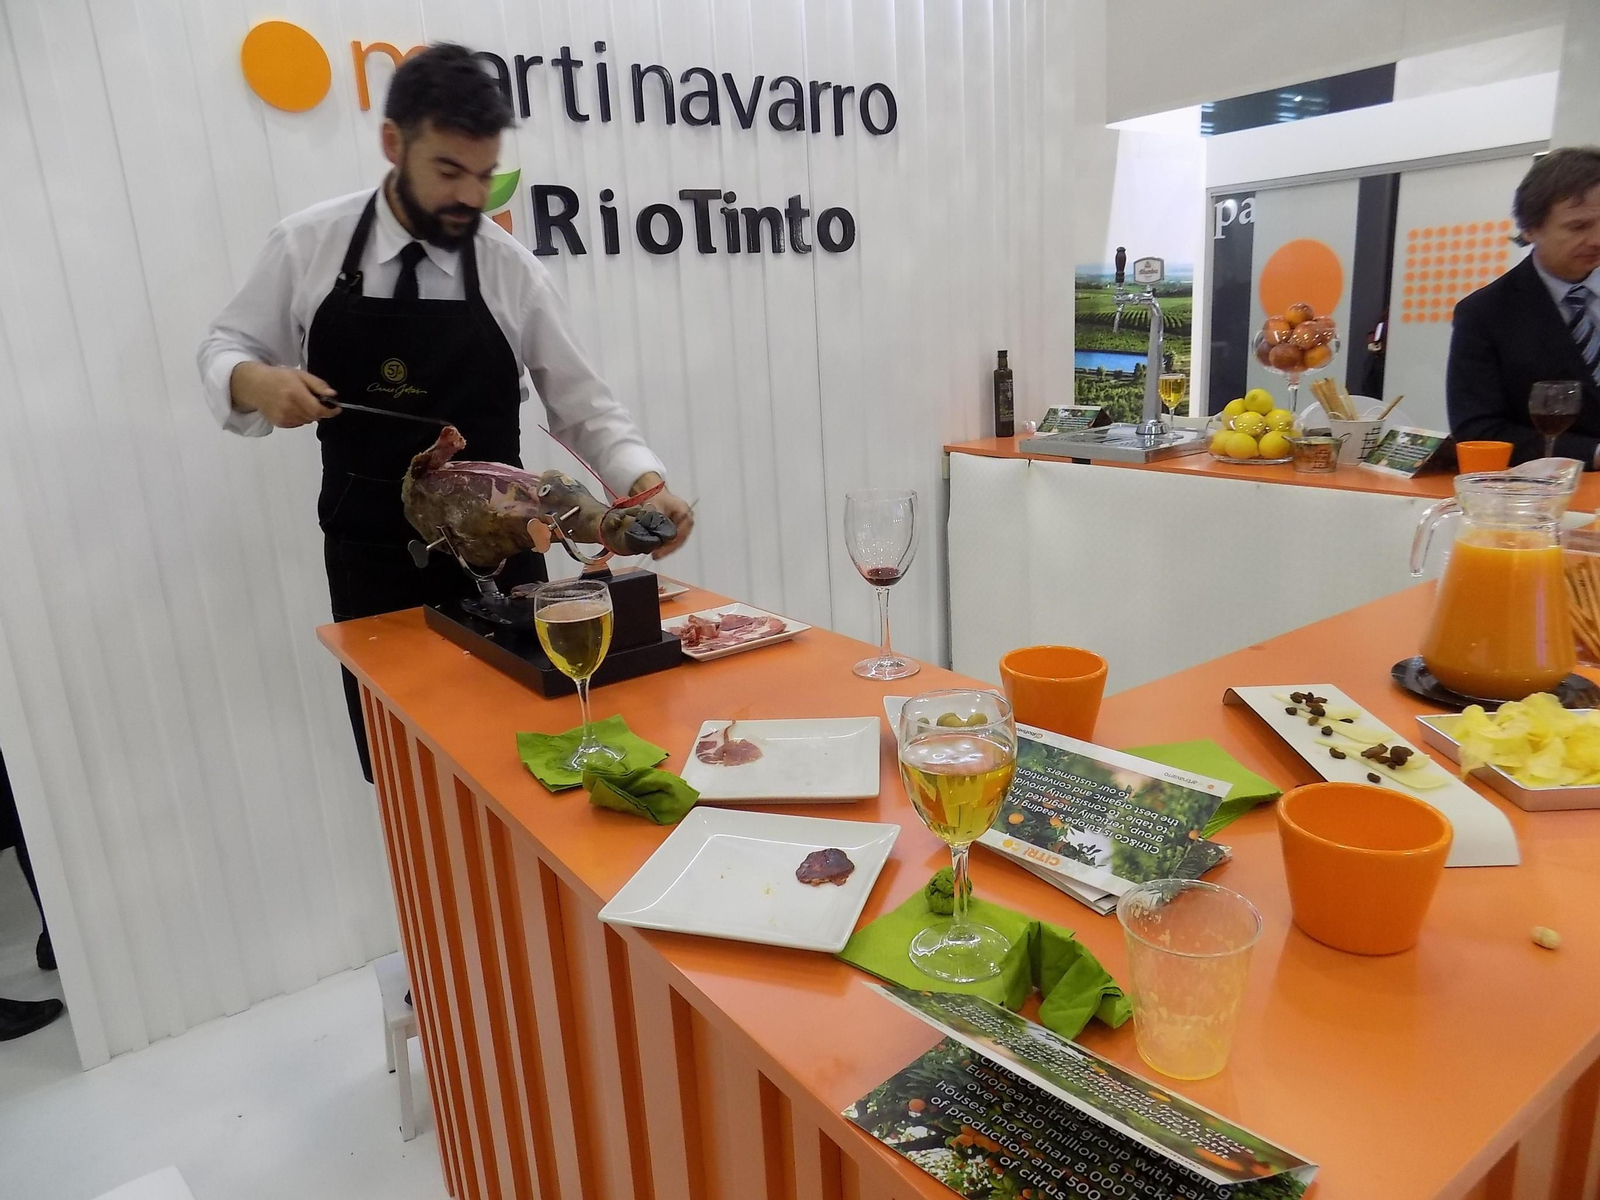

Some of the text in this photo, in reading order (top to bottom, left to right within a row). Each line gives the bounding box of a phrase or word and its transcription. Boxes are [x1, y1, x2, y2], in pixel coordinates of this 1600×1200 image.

[531, 184, 856, 256] RioTinto
[1043, 765, 1130, 799] to our customers.
[1072, 785, 1093, 797] and
[1024, 789, 1078, 814] integrated
[1045, 785, 1108, 814] consistently
[1092, 790, 1134, 811] organic
[1106, 807, 1120, 817] to
[1132, 805, 1159, 819] best
[1006, 794, 1160, 854] Citri&Co is Europe's leading fre
[1076, 807, 1126, 831] vertically
[1153, 823, 1169, 834] to
[1158, 813, 1180, 826] the
[1125, 824, 1164, 843] group,
[935, 1079, 1126, 1196] houses, more than 8.000
[965, 1064, 1034, 1106] European
[1036, 1103, 1078, 1133] citrus
[1080, 1128, 1131, 1161] group
[1134, 1158, 1174, 1187] with
[966, 1081, 999, 1104] over
[1002, 1101, 1015, 1112] €
[1014, 1107, 1045, 1130] 350
[1045, 1126, 1103, 1167] million,
[1108, 1162, 1120, 1175] 6
[930, 1096, 1101, 1200] of production and 500
[999, 1155, 1067, 1200] of citrus
